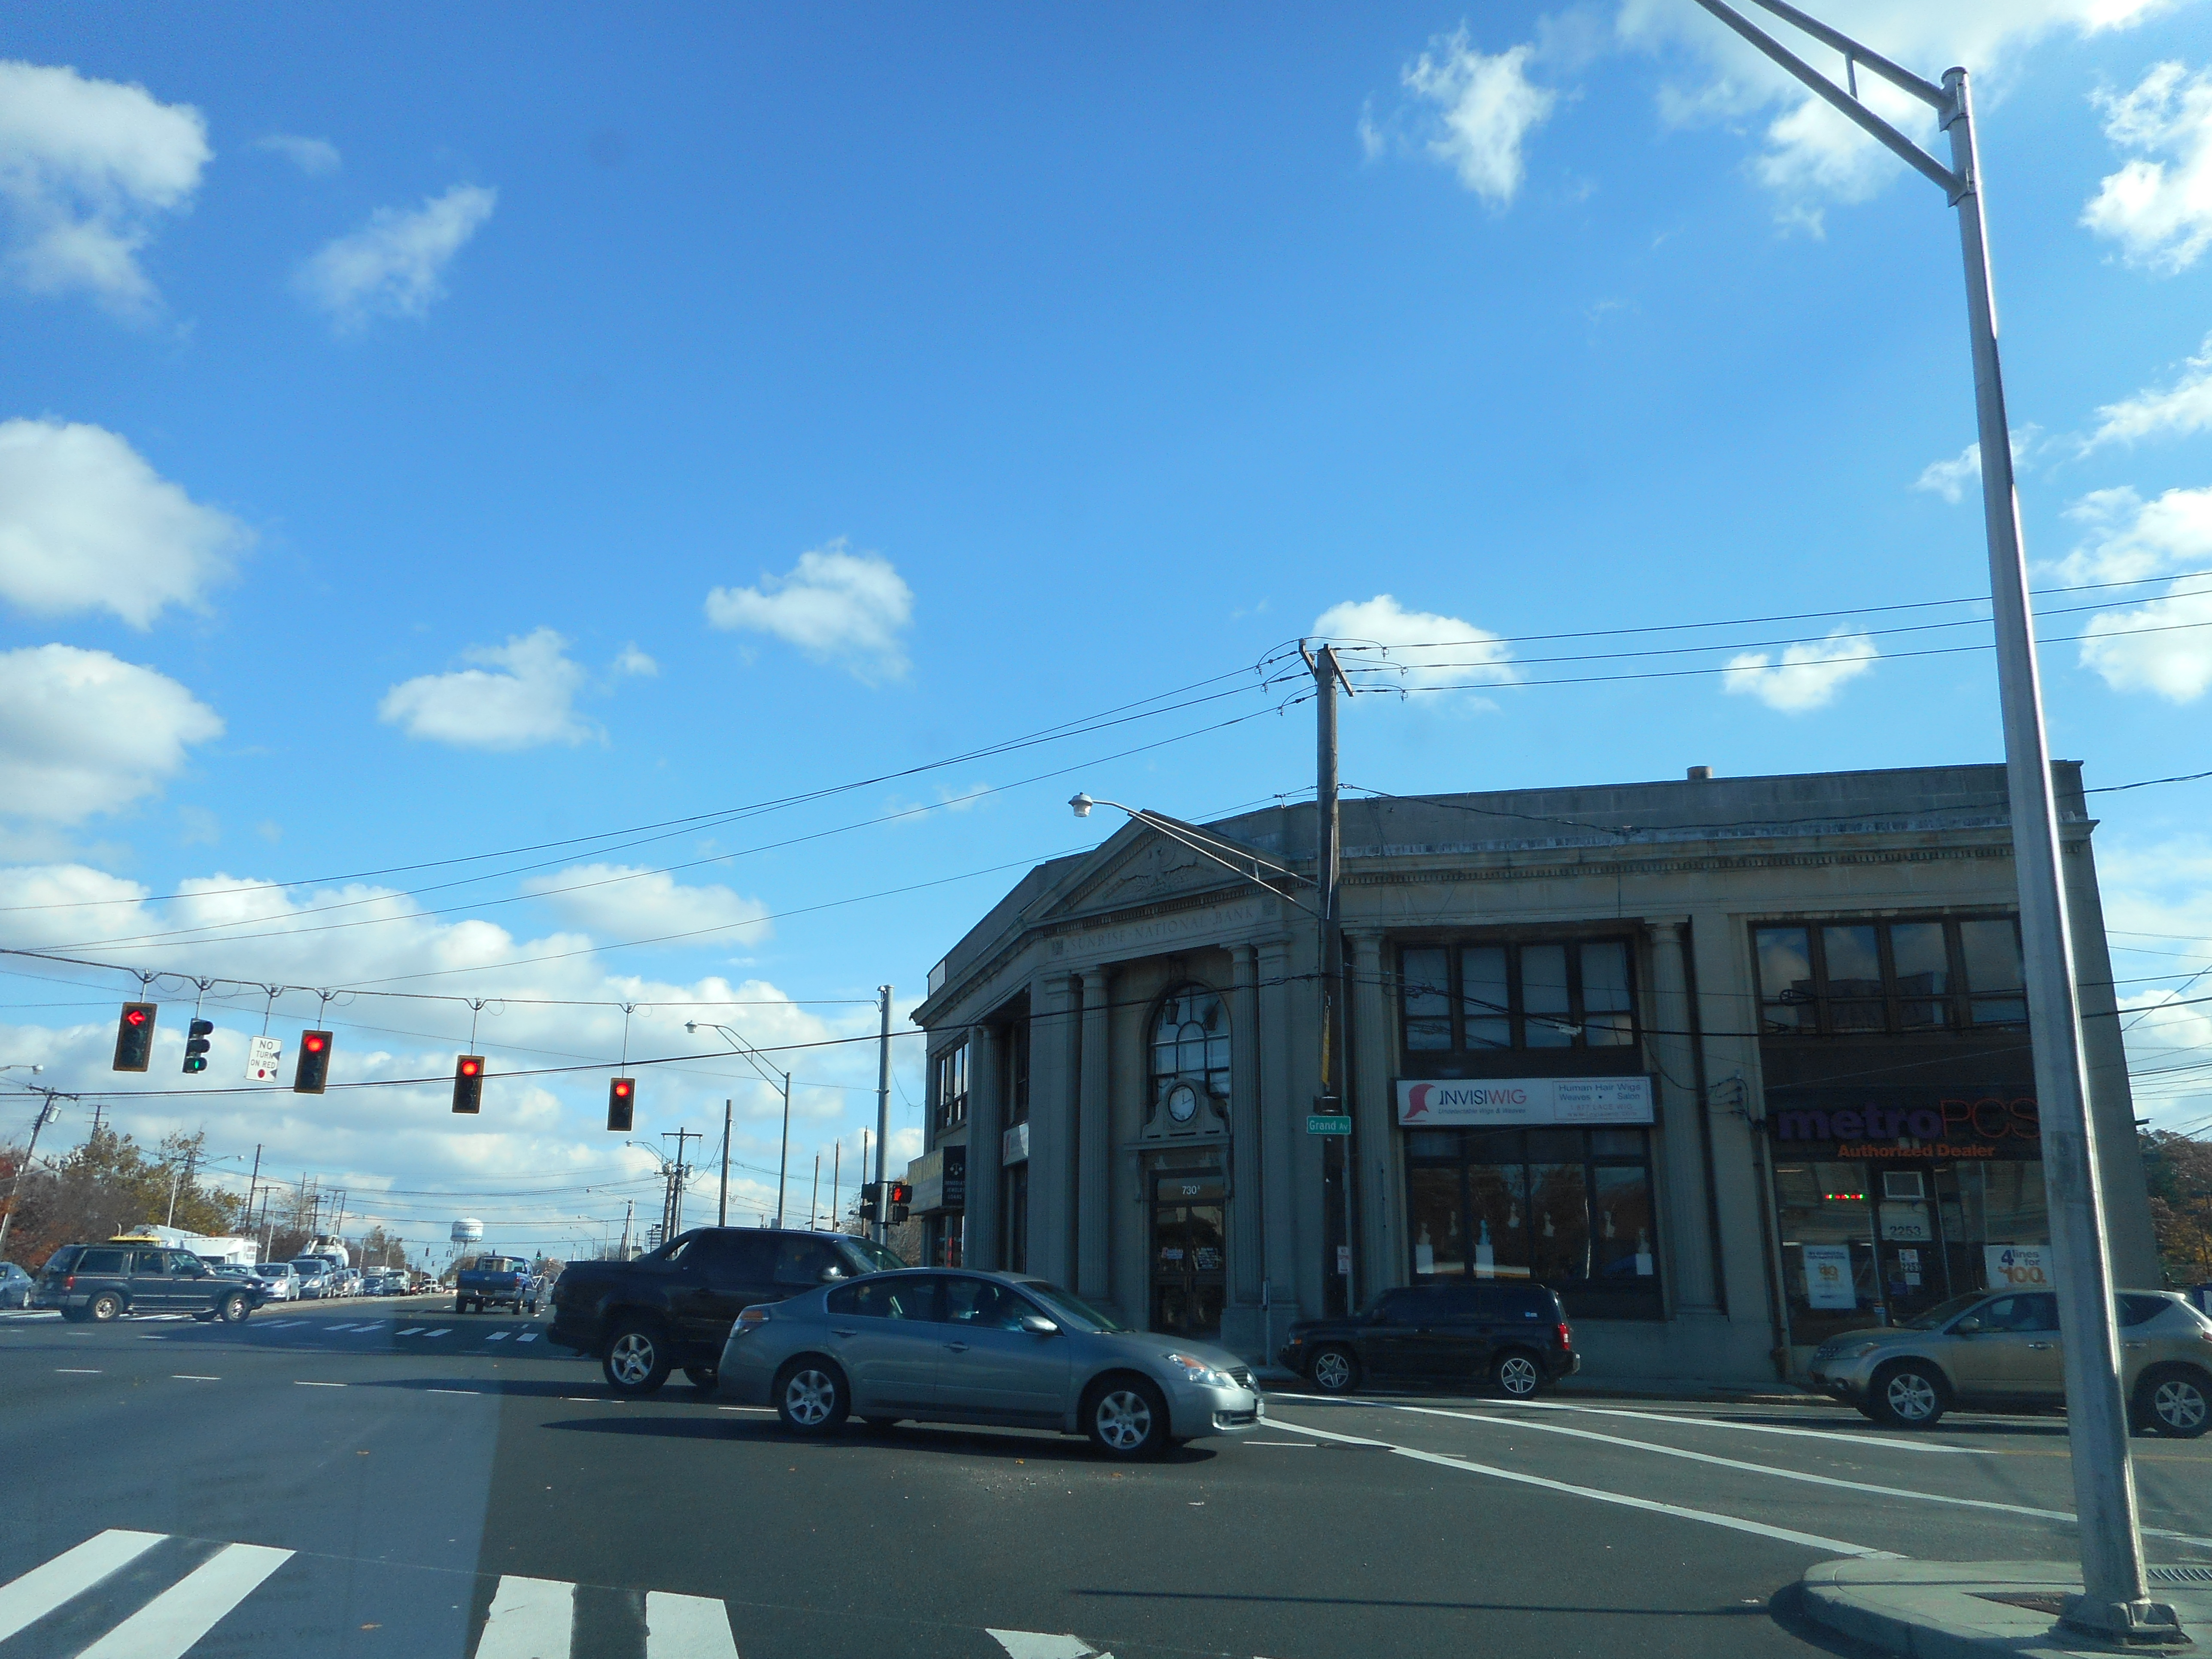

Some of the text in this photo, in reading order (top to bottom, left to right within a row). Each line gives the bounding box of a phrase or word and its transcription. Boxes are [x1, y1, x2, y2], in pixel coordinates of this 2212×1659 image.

[1071, 905, 1253, 949] SUNRISE NATIONAL BANK
[259, 1040, 273, 1050] NO
[256, 1050, 273, 1059] TURN
[262, 1060, 276, 1069] RED
[1616, 1084, 1641, 1092] Wigs
[1439, 1089, 1527, 1105] INVISIWIG
[1309, 1120, 1336, 1130] Grand
[1837, 1144, 1996, 1158] Authorized Dealer
[1890, 1226, 1921, 1236] 2253
[2001, 1250, 2039, 1266] 4 lines
